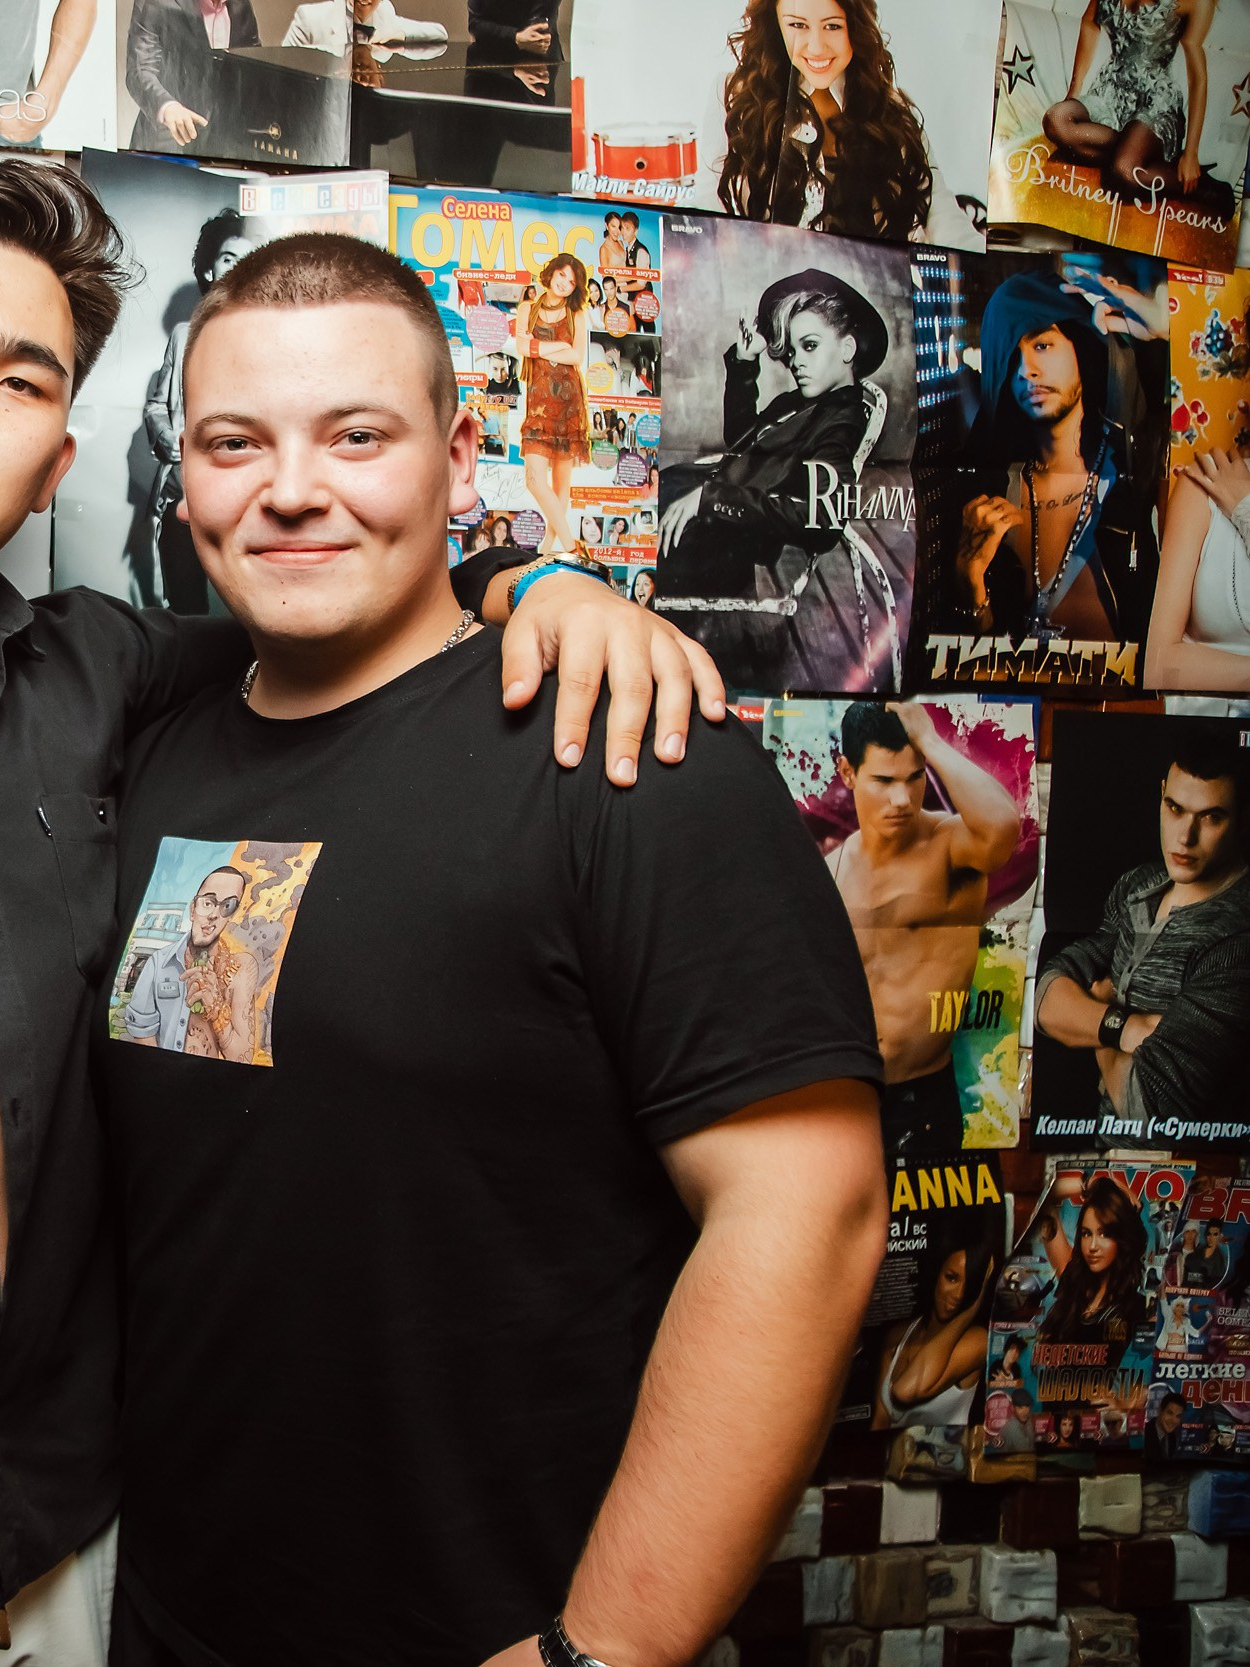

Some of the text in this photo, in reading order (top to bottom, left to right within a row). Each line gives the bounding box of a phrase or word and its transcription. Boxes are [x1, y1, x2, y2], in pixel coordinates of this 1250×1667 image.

[572, 172, 696, 203] Майли Сайрус
[1006, 144, 1227, 257] Britney Spears
[443, 198, 510, 220] Селена
[389, 194, 594, 278] Гомес
[671, 224, 703, 235] BRAVO
[916, 253, 947, 262] BRAVO
[455, 373, 484, 383] умиры
[802, 460, 916, 532] RIHANNA
[926, 633, 1139, 687] ТИМАТИ
[928, 989, 1005, 1034] TAYLOR
[1036, 1115, 1097, 1136] Келлан
[1099, 1115, 1143, 1138] Латц
[891, 1163, 1001, 1213] ANNA
[887, 1236, 928, 1253] ийский
[1031, 1343, 1109, 1367] НЕДЕТСКИЕ
[1155, 1363, 1245, 1379] легкие
[1037, 1367, 1145, 1403] ШАЛОСТИ
